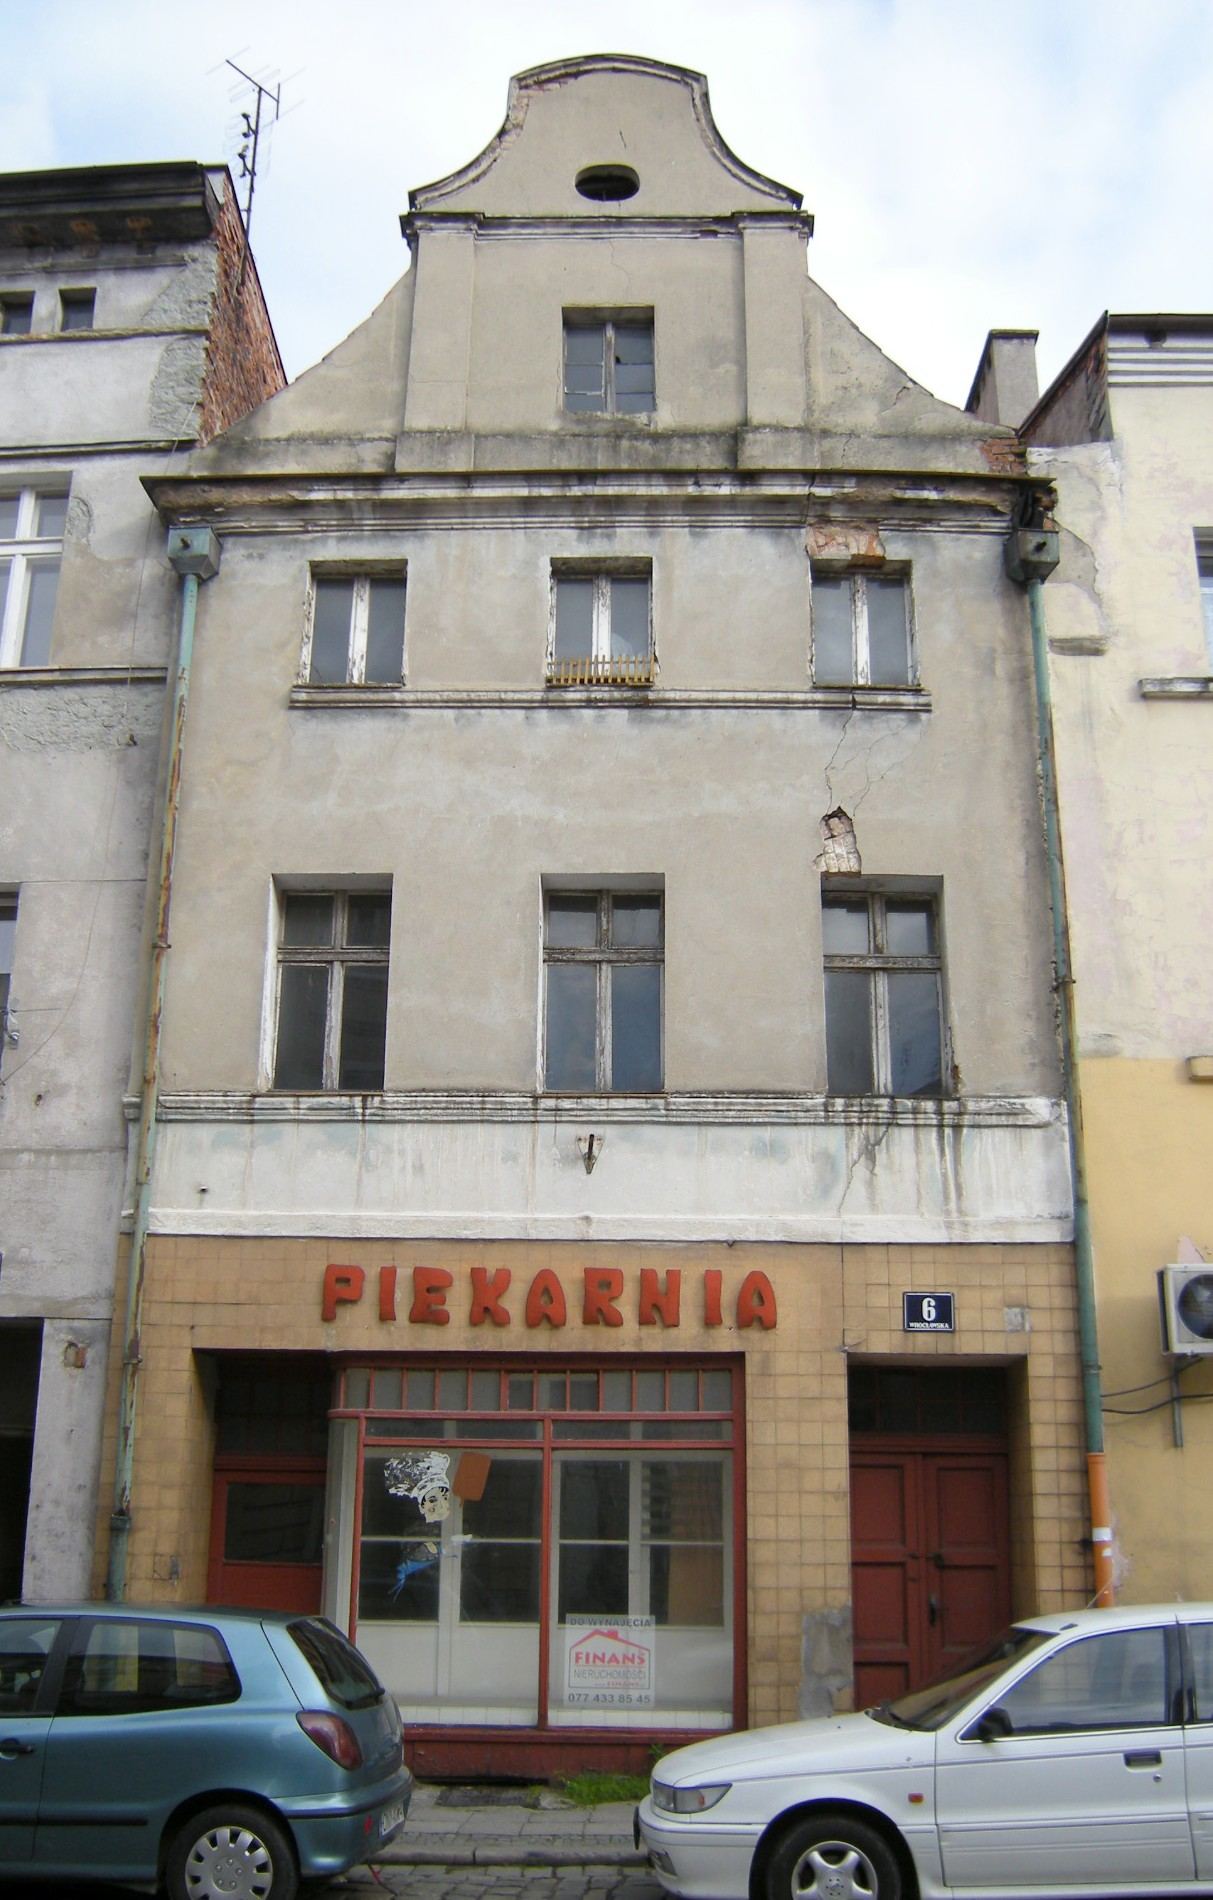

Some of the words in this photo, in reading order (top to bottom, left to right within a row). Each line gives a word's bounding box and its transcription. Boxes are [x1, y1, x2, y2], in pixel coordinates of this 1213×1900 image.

[321, 1264, 777, 1330] PIEKARNIA
[922, 1297, 936, 1321] 6
[570, 1617, 585, 1626] DO
[575, 1651, 646, 1665] FINANS
[568, 1693, 589, 1703] 077
[593, 1694, 615, 1704] 433
[618, 1694, 633, 1704] 85
[636, 1695, 651, 1704] 45
